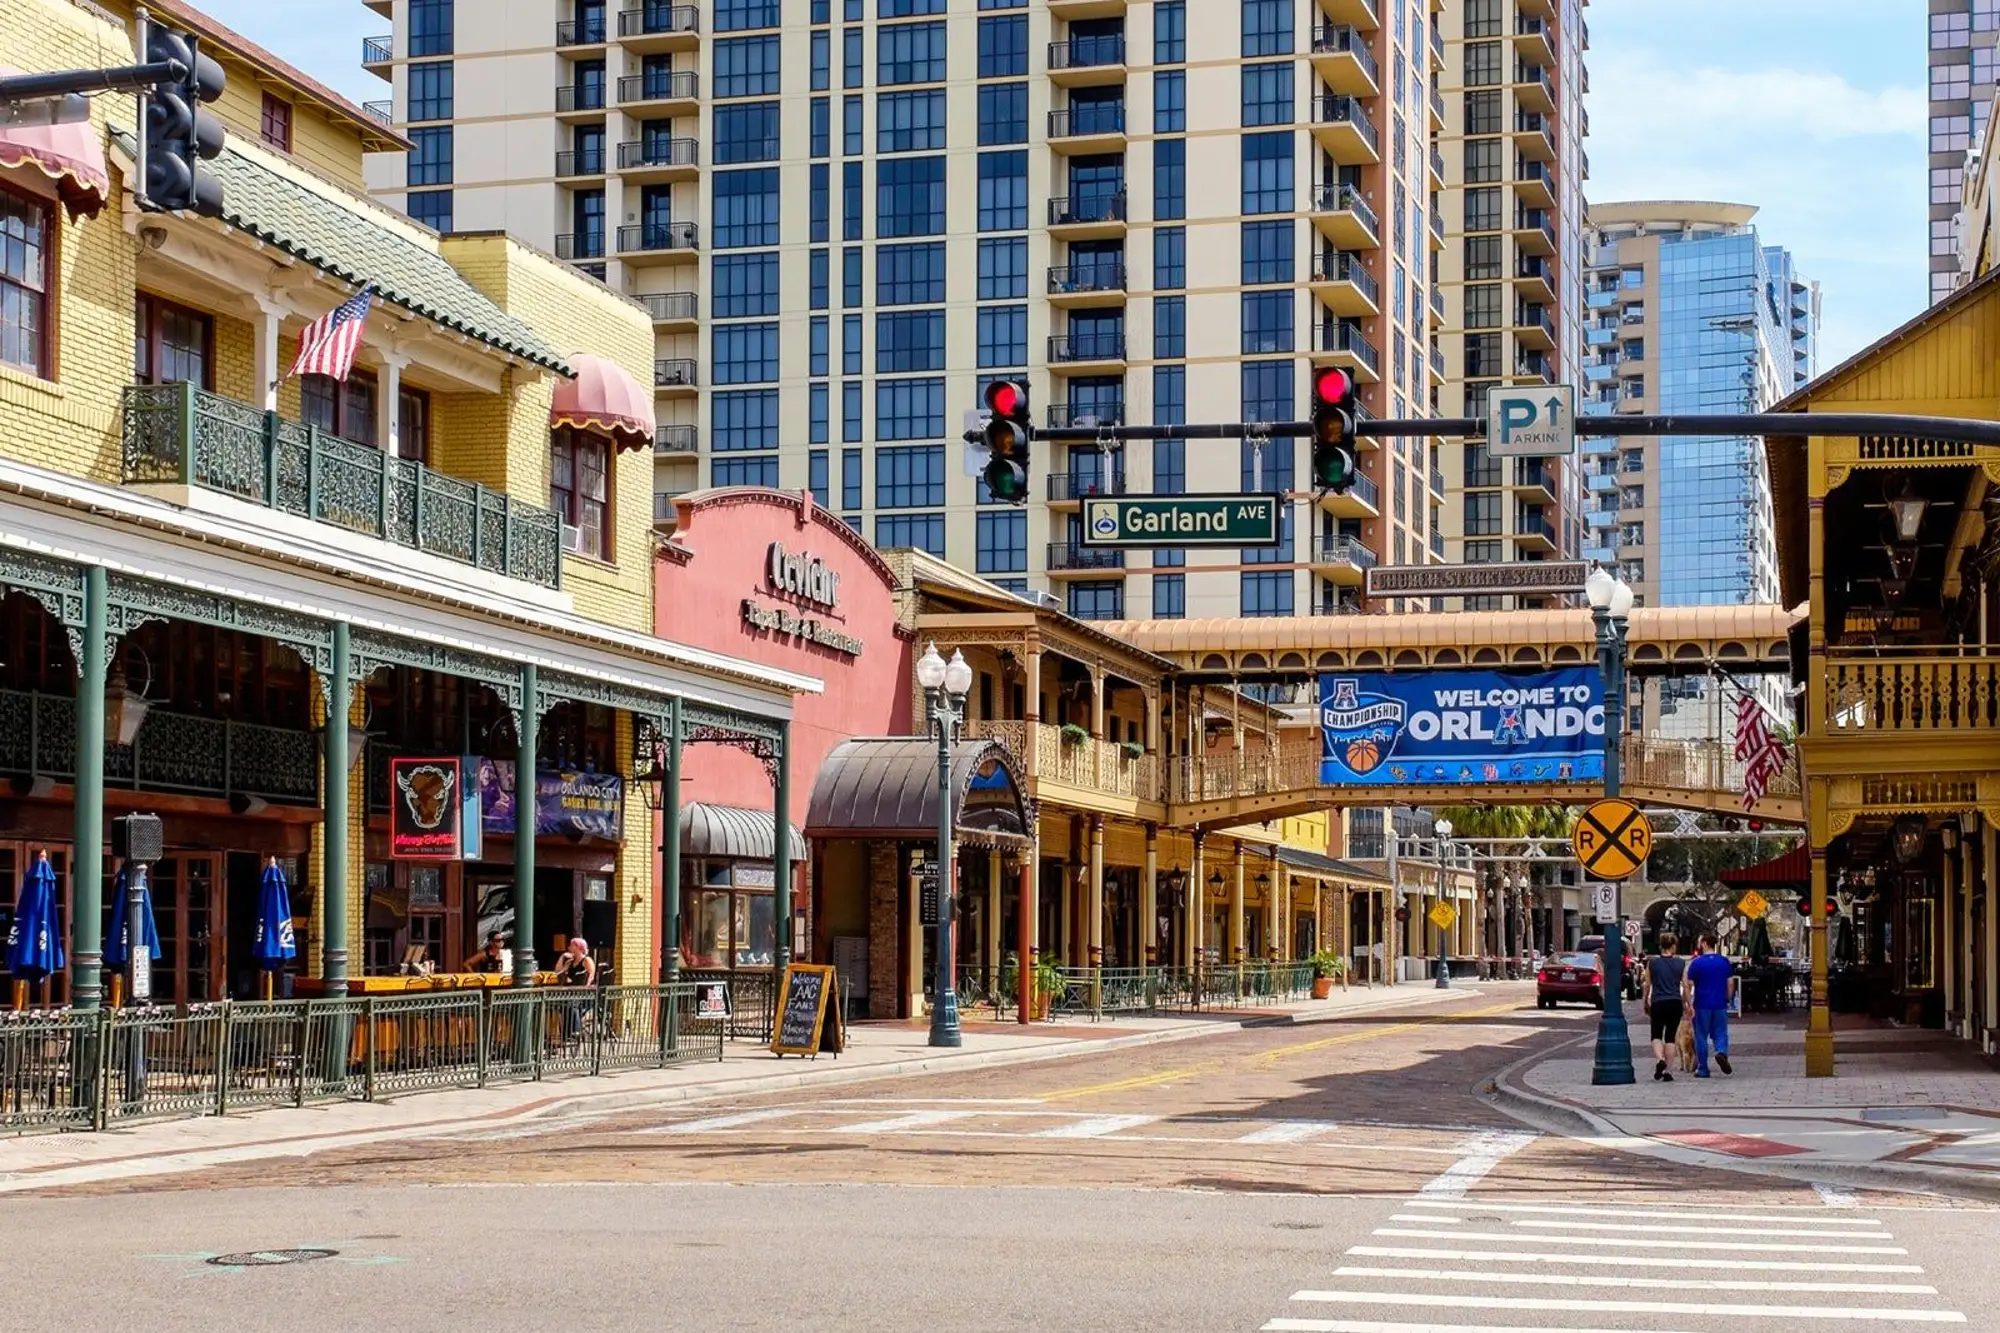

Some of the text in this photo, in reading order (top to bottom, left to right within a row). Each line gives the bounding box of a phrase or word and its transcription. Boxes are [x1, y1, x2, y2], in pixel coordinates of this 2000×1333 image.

[1126, 506, 1266, 532] Garland AVE
[1373, 567, 1581, 590] CHURCH STREET STATION
[1434, 685, 1590, 707] WELCOME TO
[1326, 705, 1400, 727] CHAMPIONSHIP
[561, 782, 600, 798] ORLANDO
[1580, 829, 1645, 850] R R
[795, 984, 817, 999] AAC
[788, 998, 814, 1010] FANS
